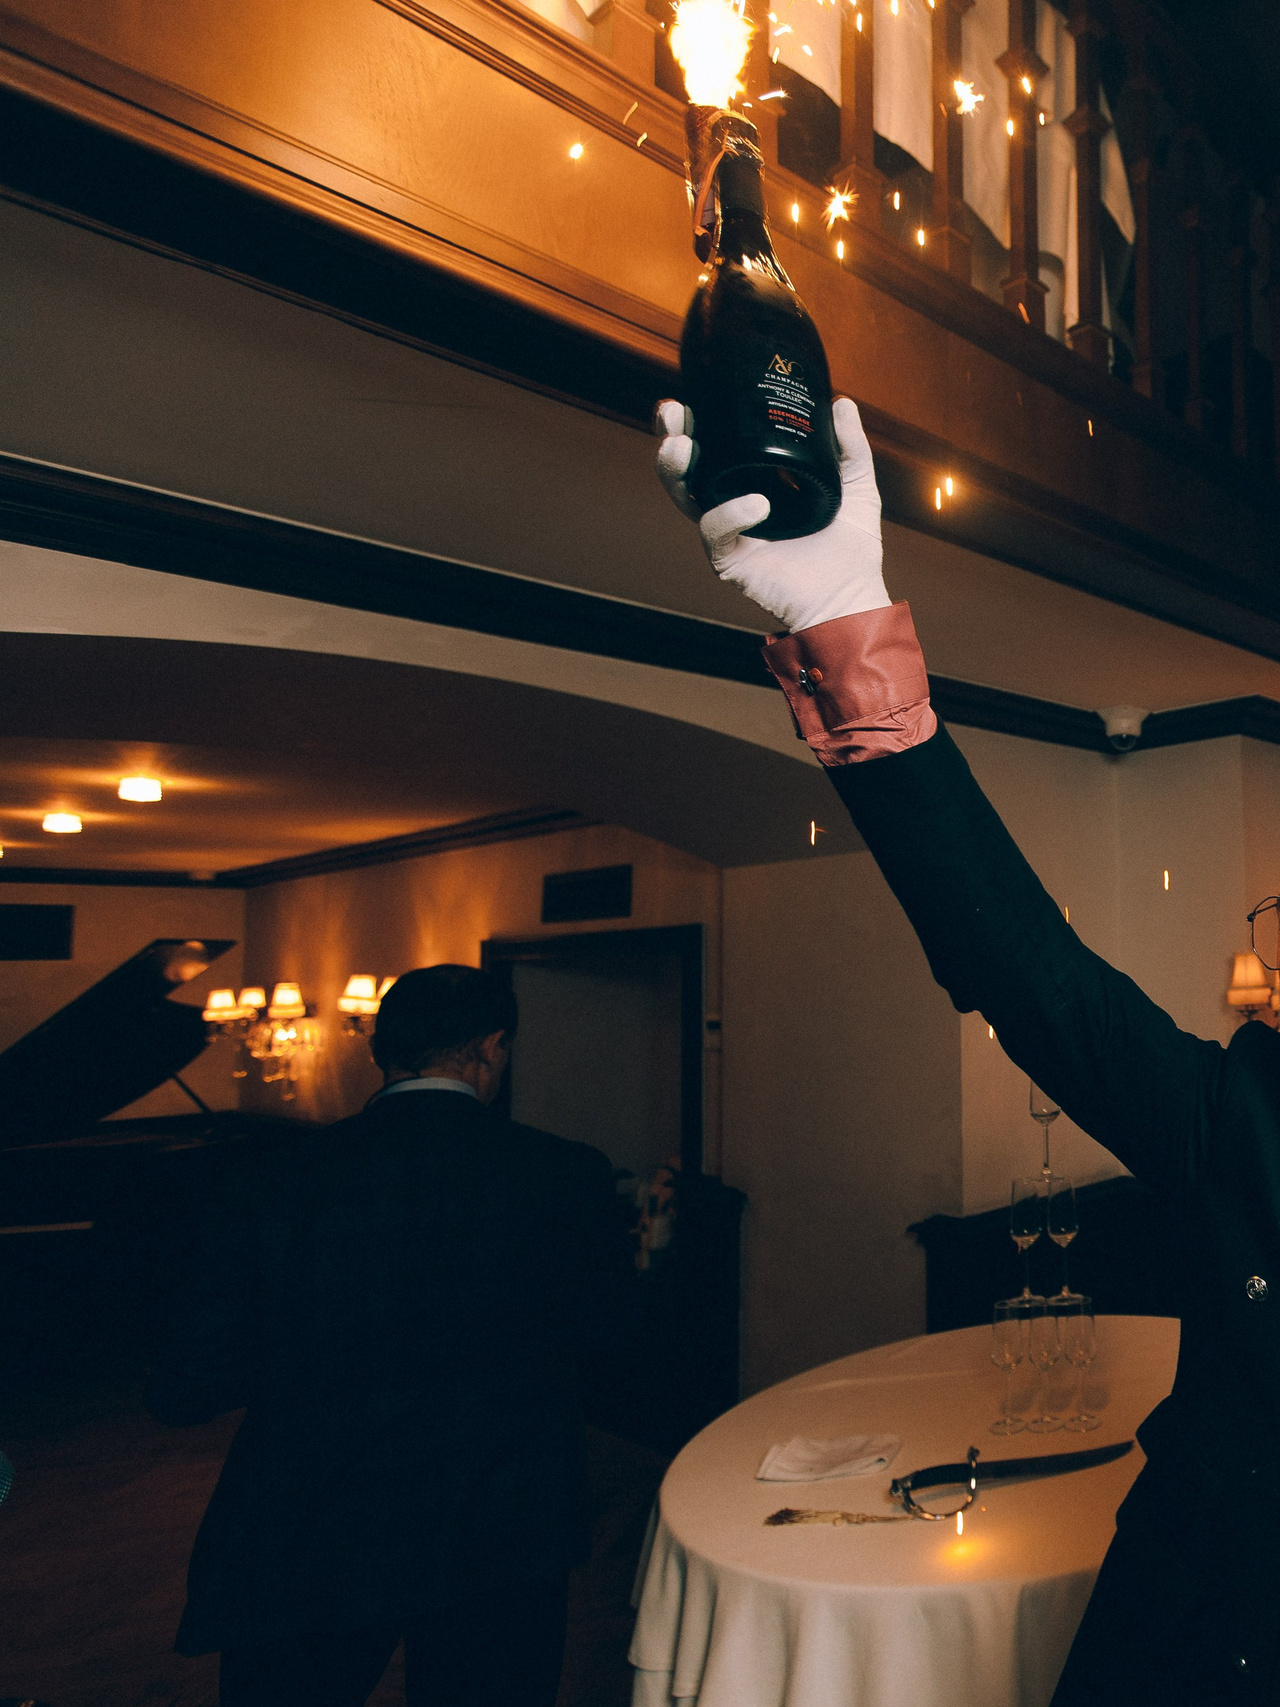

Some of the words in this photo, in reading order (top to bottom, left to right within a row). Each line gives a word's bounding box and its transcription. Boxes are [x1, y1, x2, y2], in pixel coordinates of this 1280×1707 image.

[757, 383, 785, 392] ANTHONY
[765, 373, 808, 392] CHAMPAGNE
[775, 390, 803, 405] TOULLEC
[768, 409, 810, 427] ASSEMBLAGE
[775, 424, 796, 434] PREMIER
[796, 430, 807, 438] CRU
